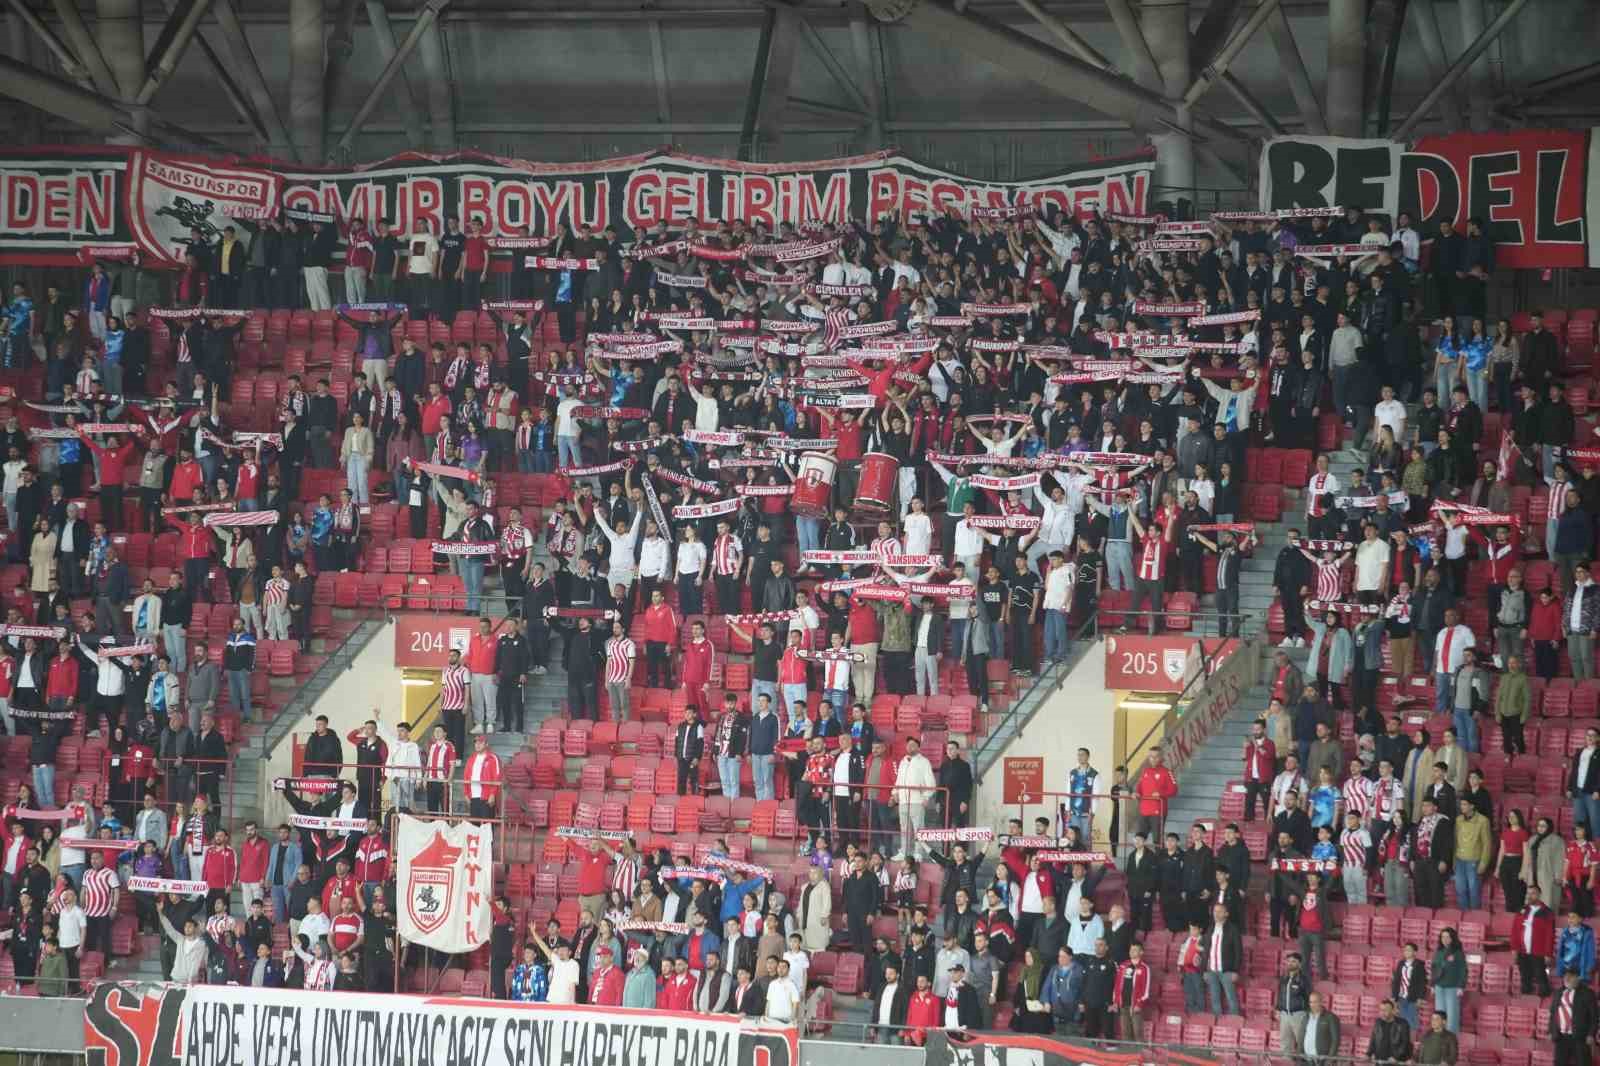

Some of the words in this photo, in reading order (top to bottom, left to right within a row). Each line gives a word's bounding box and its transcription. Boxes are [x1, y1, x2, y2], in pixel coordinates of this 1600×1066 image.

[6, 172, 113, 233] DEN
[148, 162, 258, 197] SAMSUNSPOR
[462, 177, 607, 240] BOYU
[410, 631, 443, 653] 204
[1121, 652, 1158, 675] 205
[186, 1001, 245, 1066] AHDE
